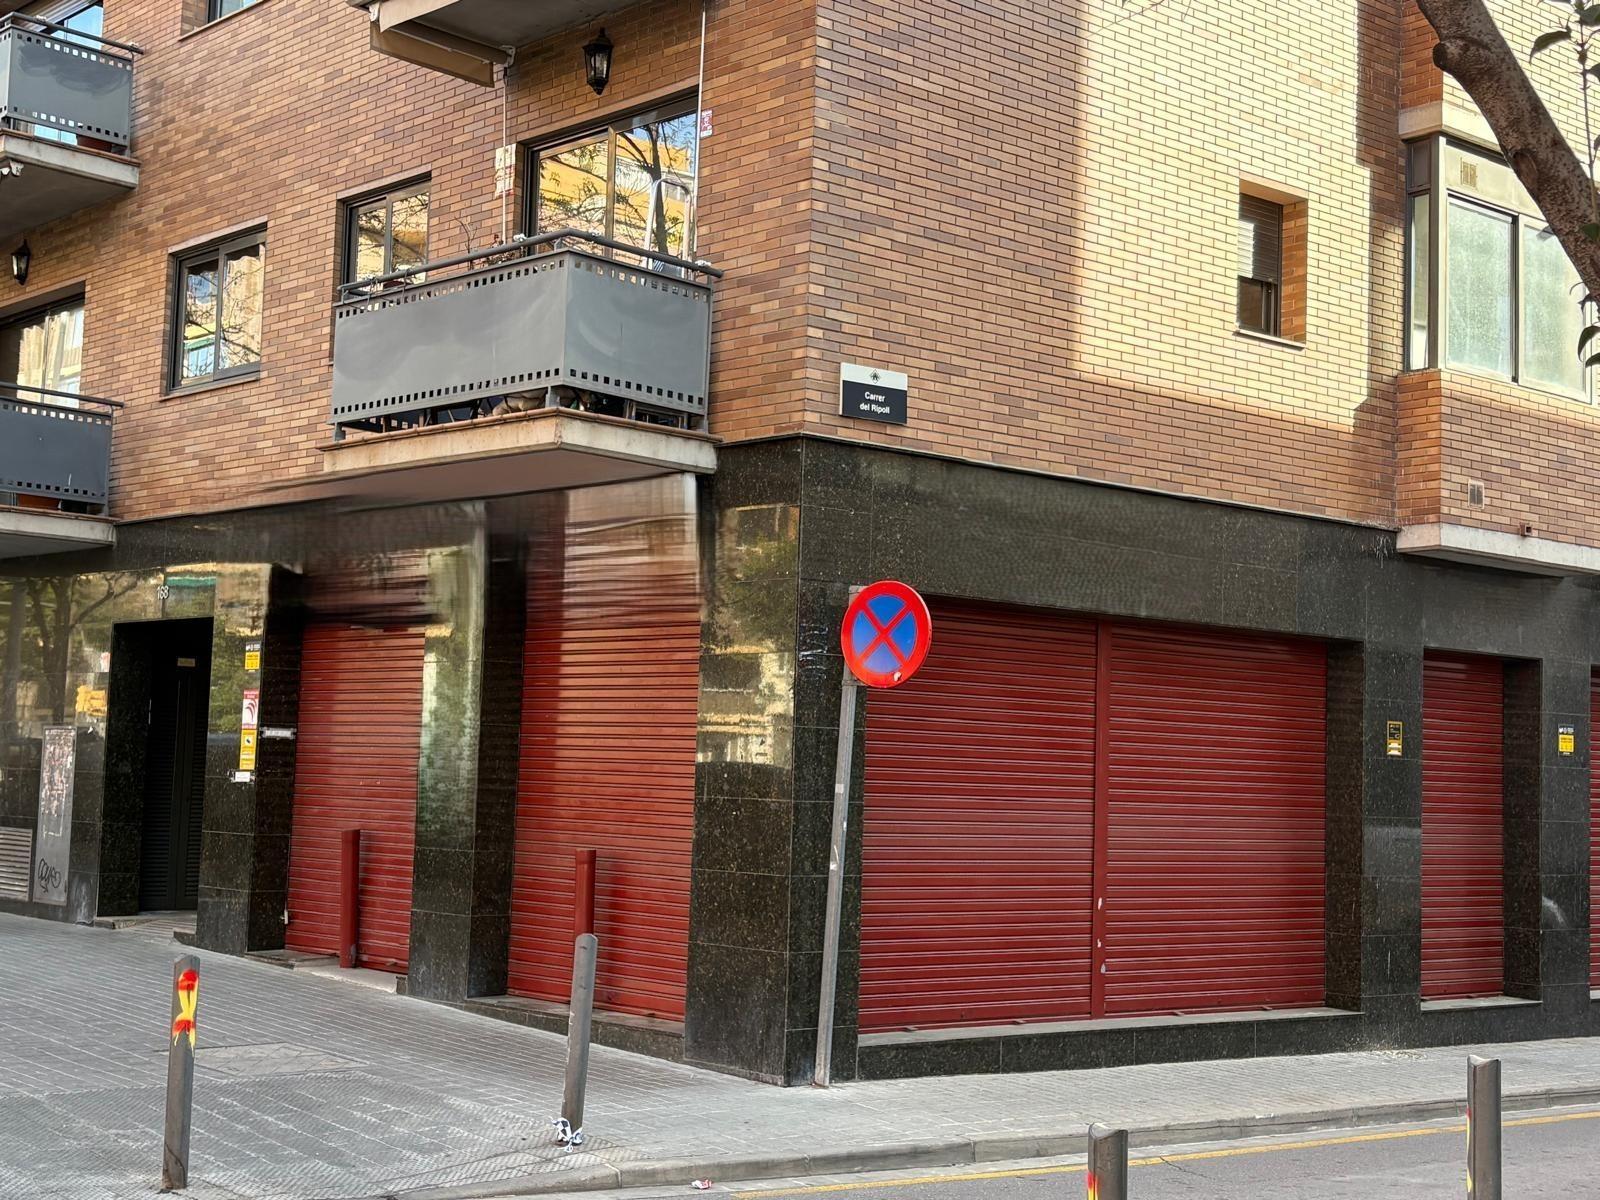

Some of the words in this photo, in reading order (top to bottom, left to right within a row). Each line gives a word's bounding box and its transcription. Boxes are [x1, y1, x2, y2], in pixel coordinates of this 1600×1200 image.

[864, 391, 885, 402] Carrer
[859, 403, 870, 411] del
[871, 404, 890, 414] Ripoll
[157, 585, 169, 600] 168
